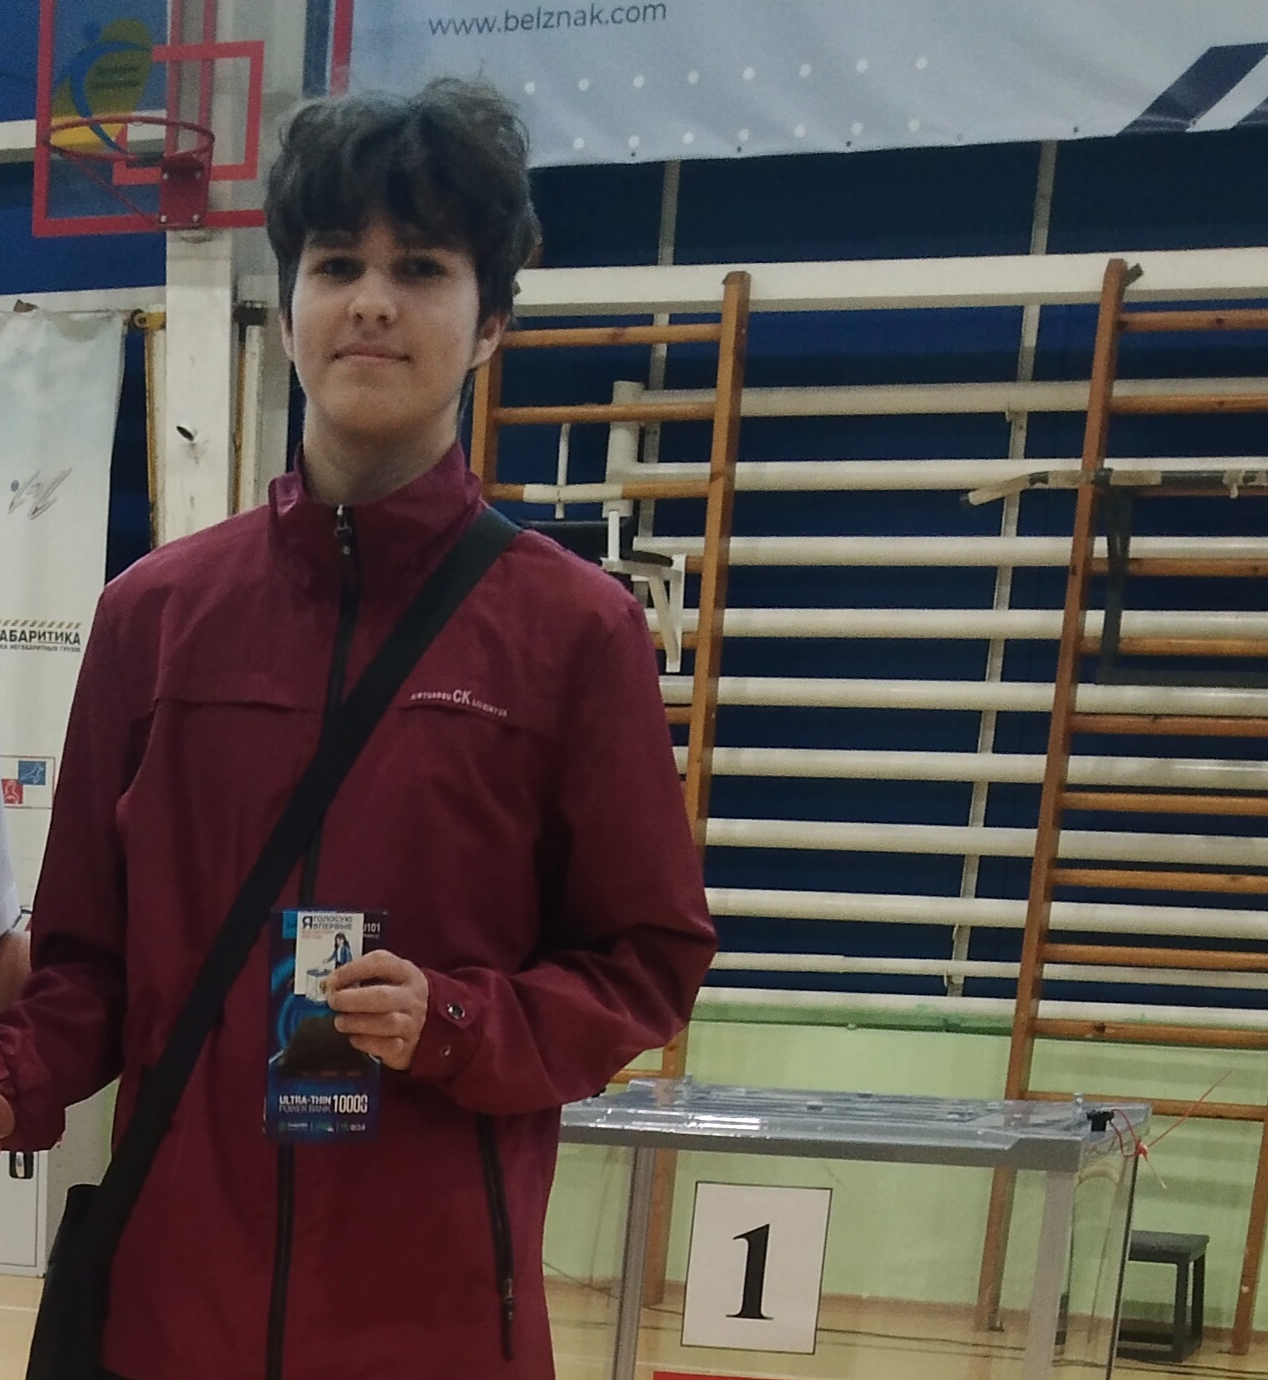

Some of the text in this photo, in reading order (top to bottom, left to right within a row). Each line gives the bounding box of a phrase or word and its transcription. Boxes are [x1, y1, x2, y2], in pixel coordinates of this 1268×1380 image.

[428, 2, 668, 35] www.belznak.com
[302, 915, 313, 930] Я
[279, 1095, 332, 1105] ULTRA-THIN
[725, 1223, 774, 1320] 1
